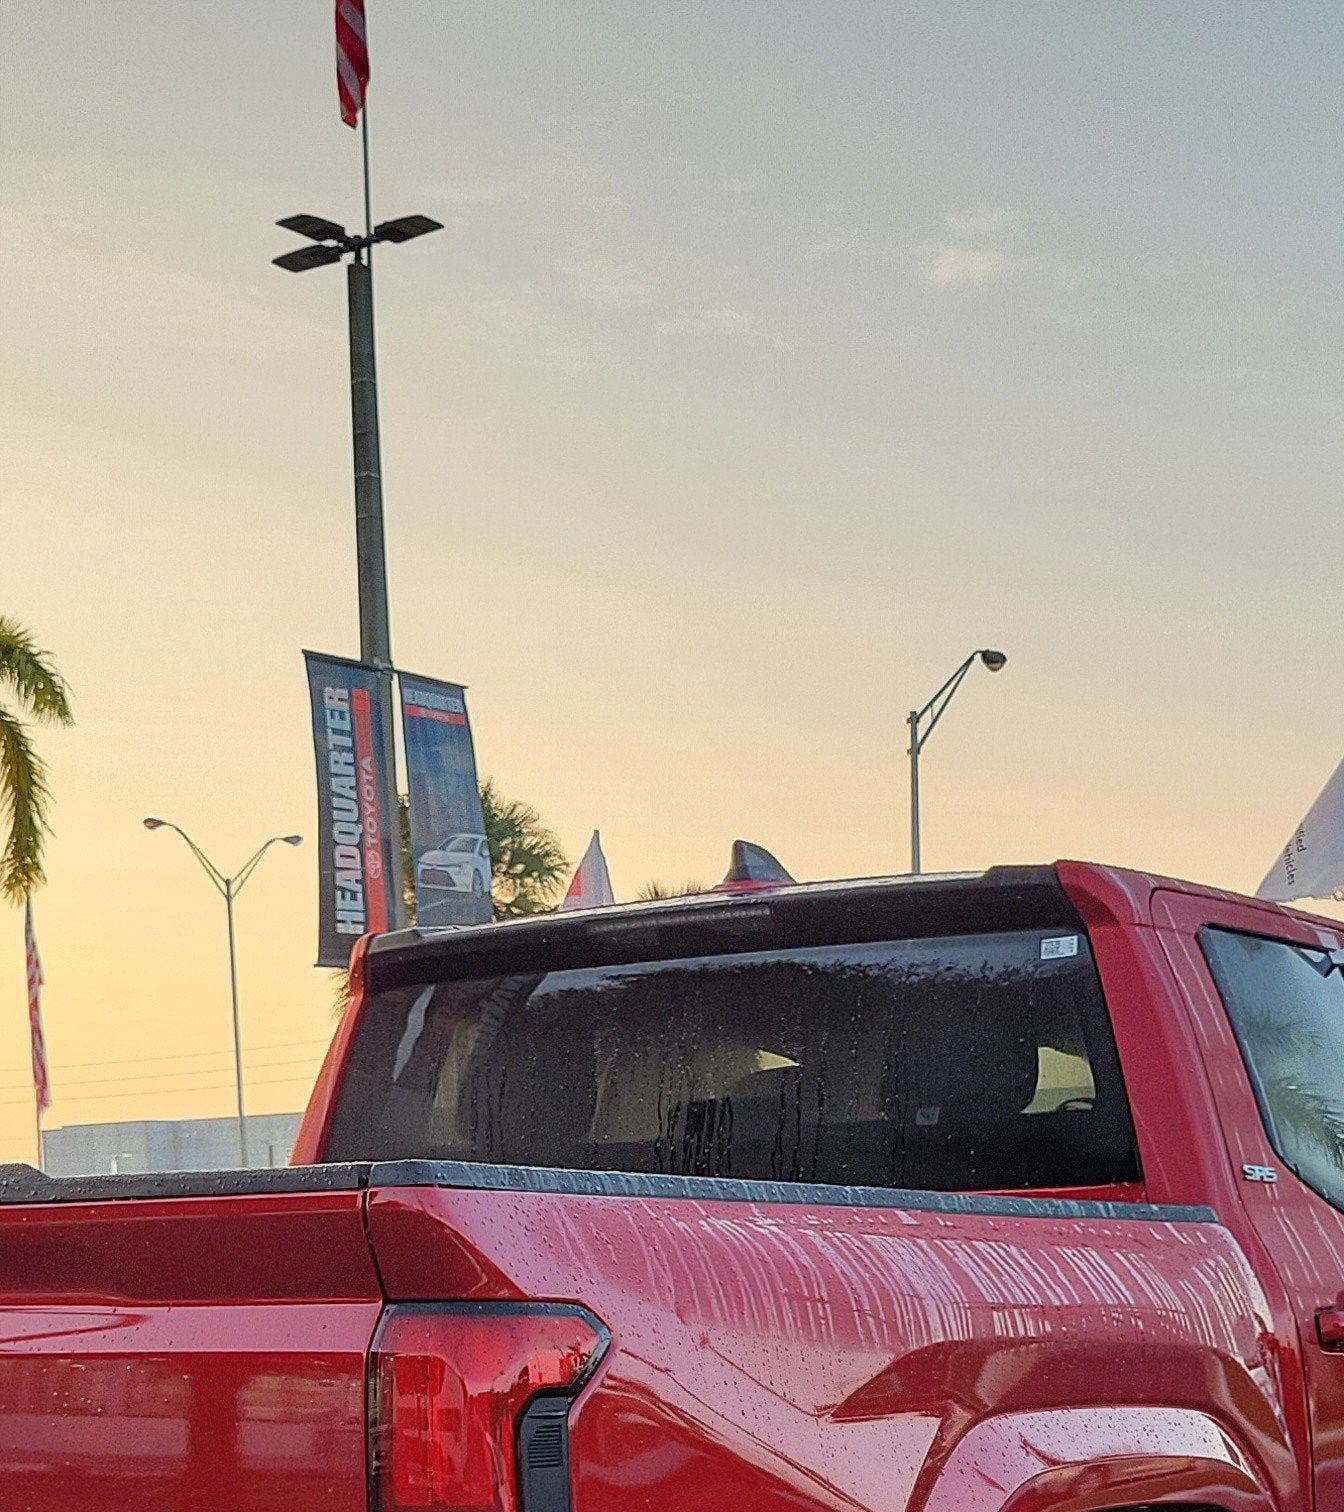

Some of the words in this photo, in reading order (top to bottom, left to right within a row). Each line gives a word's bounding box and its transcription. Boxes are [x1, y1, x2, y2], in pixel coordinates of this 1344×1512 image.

[323, 686, 365, 935] HEADQUARTER
[360, 755, 379, 847] TOYOTA
[1242, 1163, 1277, 1183] SR5
